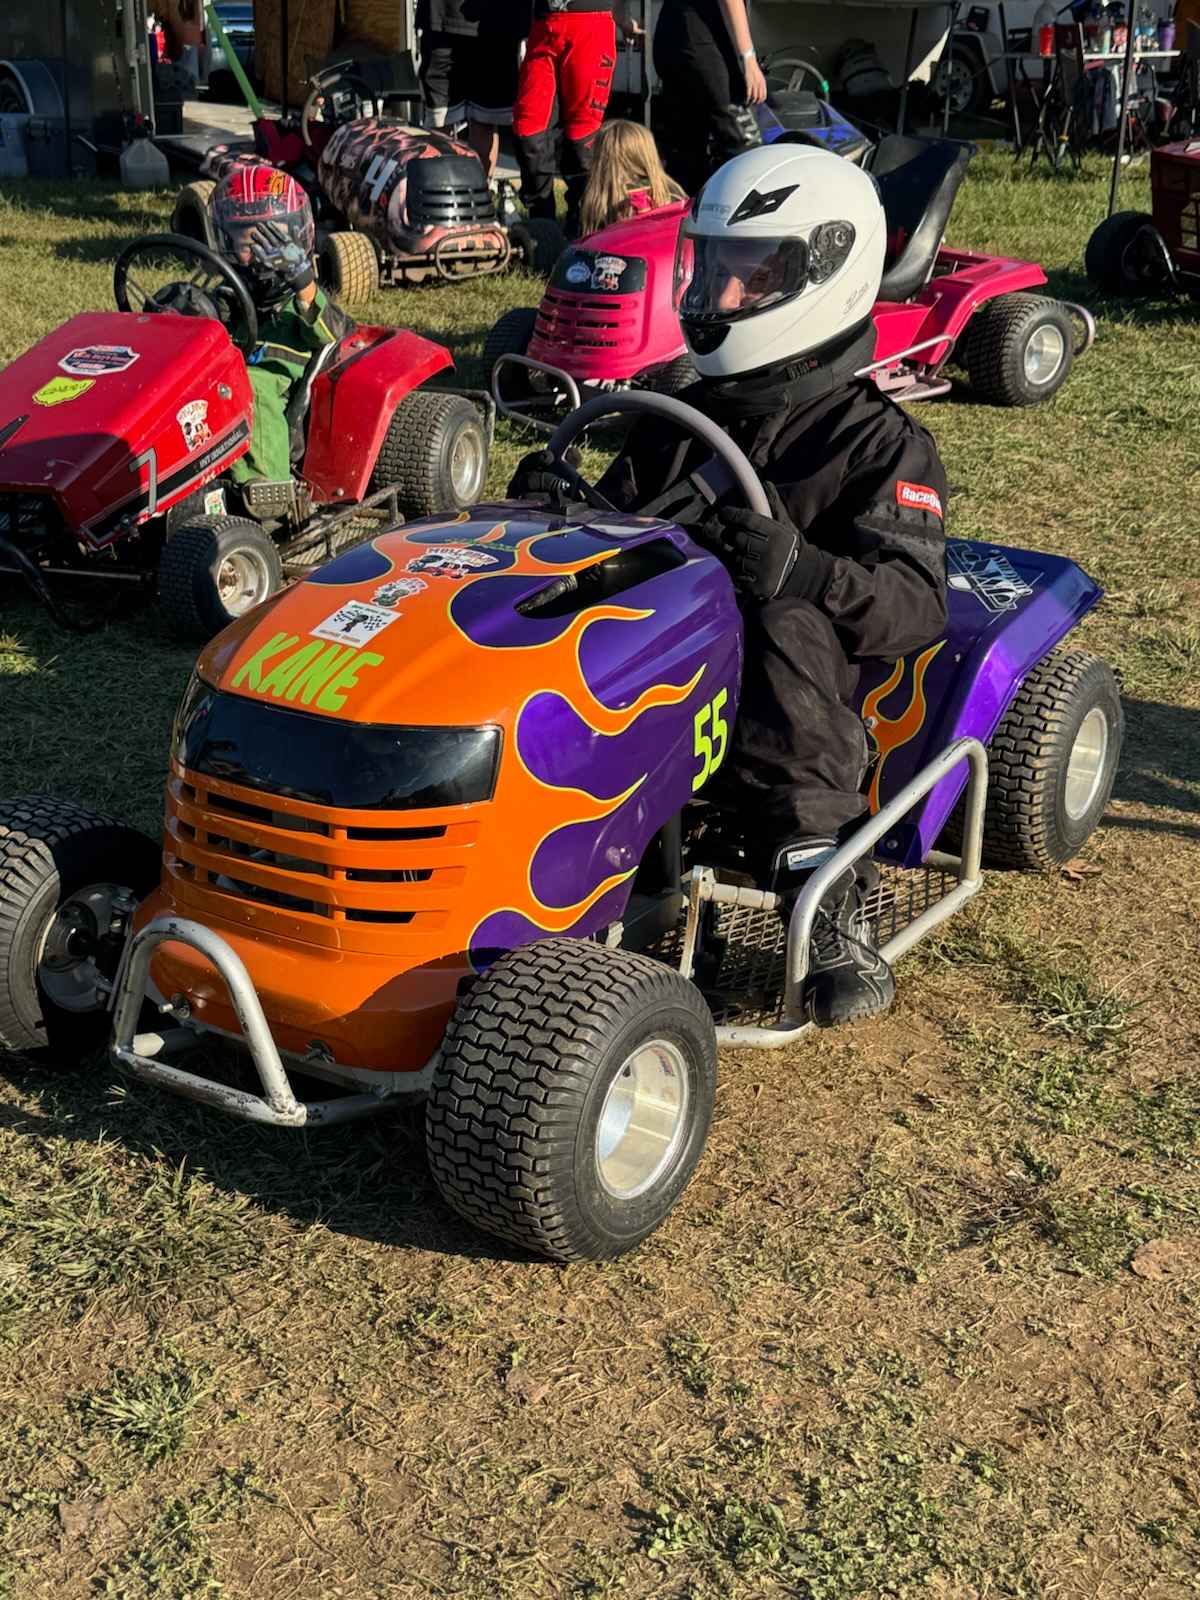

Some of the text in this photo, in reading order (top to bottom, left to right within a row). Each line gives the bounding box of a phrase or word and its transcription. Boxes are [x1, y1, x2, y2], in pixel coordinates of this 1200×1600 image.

[367, 154, 398, 202] 4
[128, 447, 157, 513] 7
[231, 632, 385, 712] KANE
[692, 687, 728, 792] 55
